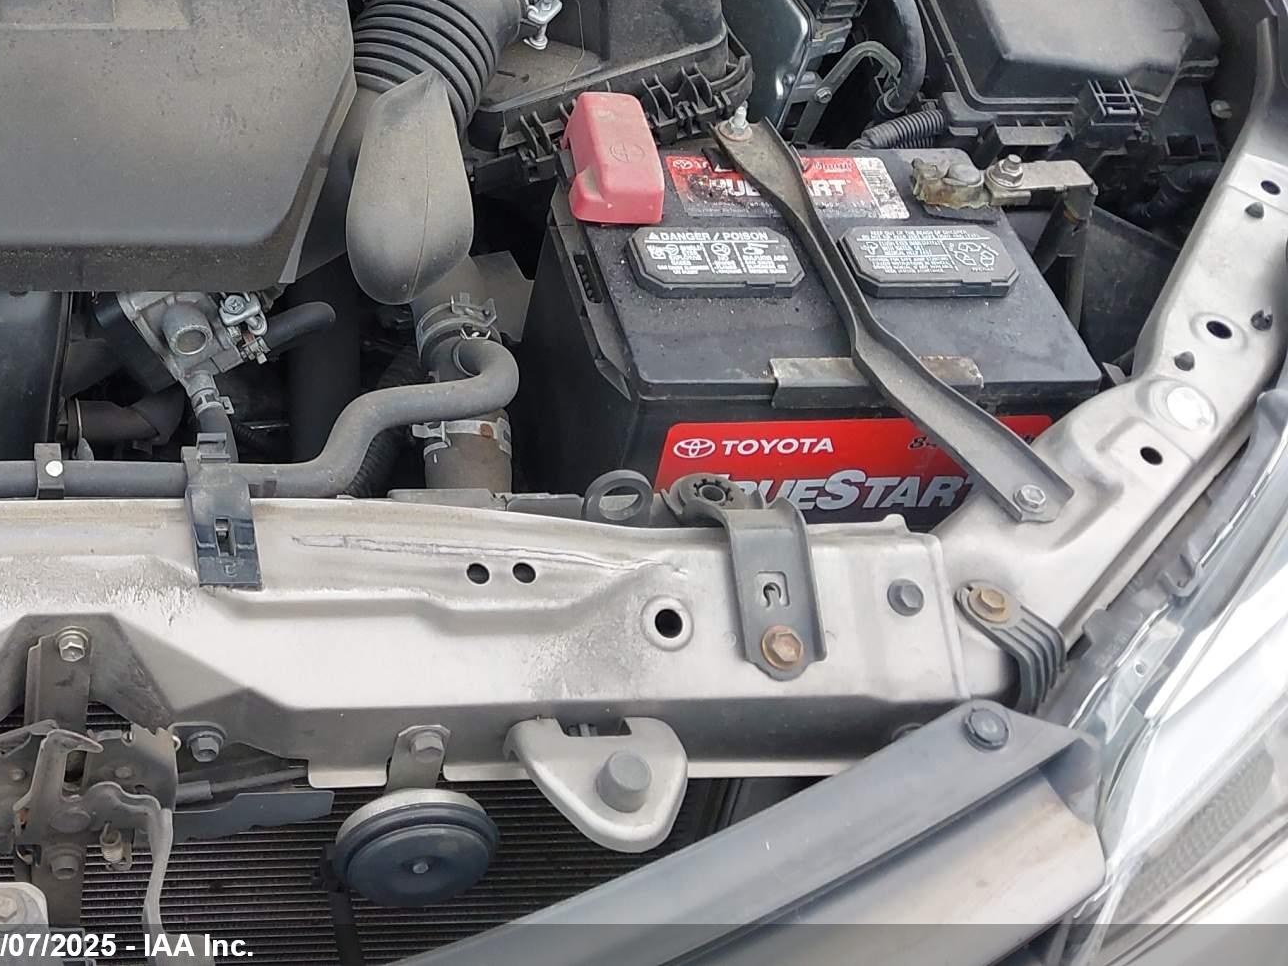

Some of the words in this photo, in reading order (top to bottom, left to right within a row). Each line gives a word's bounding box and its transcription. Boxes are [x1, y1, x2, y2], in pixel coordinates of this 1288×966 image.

[661, 232, 711, 241] DANGER
[723, 232, 769, 241] POISON
[721, 437, 834, 456] TOYOTA
[715, 469, 988, 510] UESTAR
